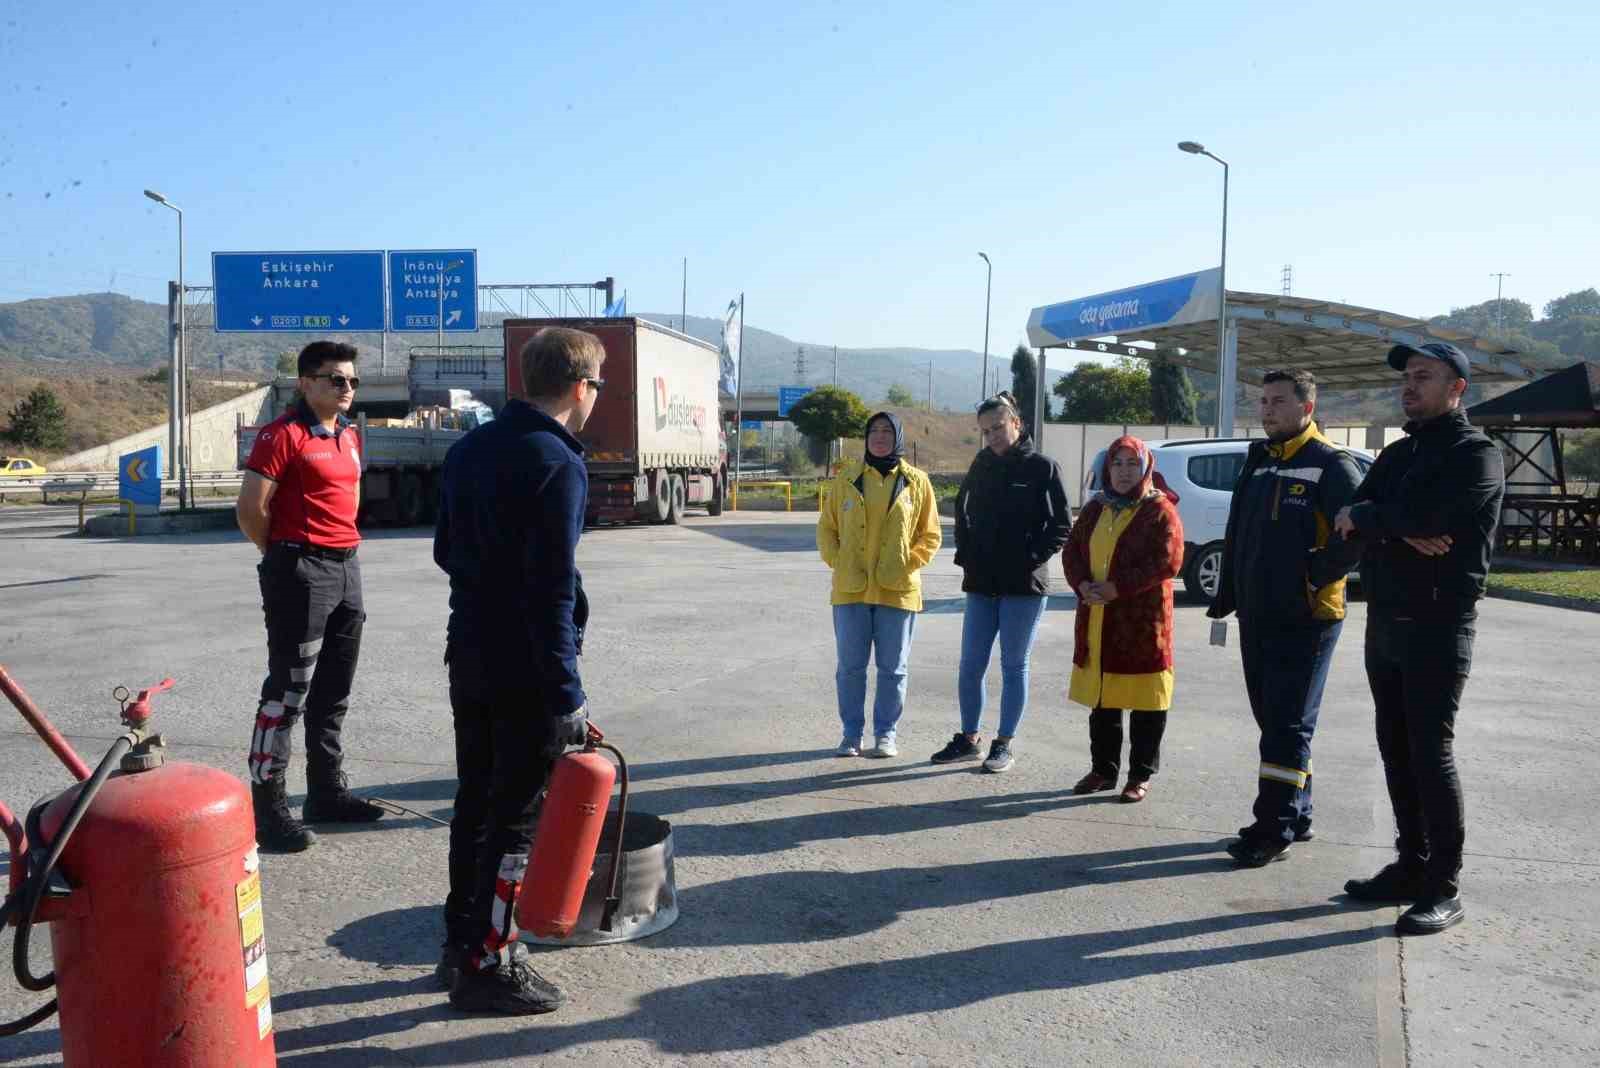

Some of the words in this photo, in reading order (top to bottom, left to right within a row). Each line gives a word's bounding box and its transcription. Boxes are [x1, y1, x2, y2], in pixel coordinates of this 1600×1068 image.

[261, 261, 335, 275] Eskişehir
[403, 258, 444, 271] İnönü
[263, 277, 320, 288] Ankara
[405, 287, 459, 301] Antaya
